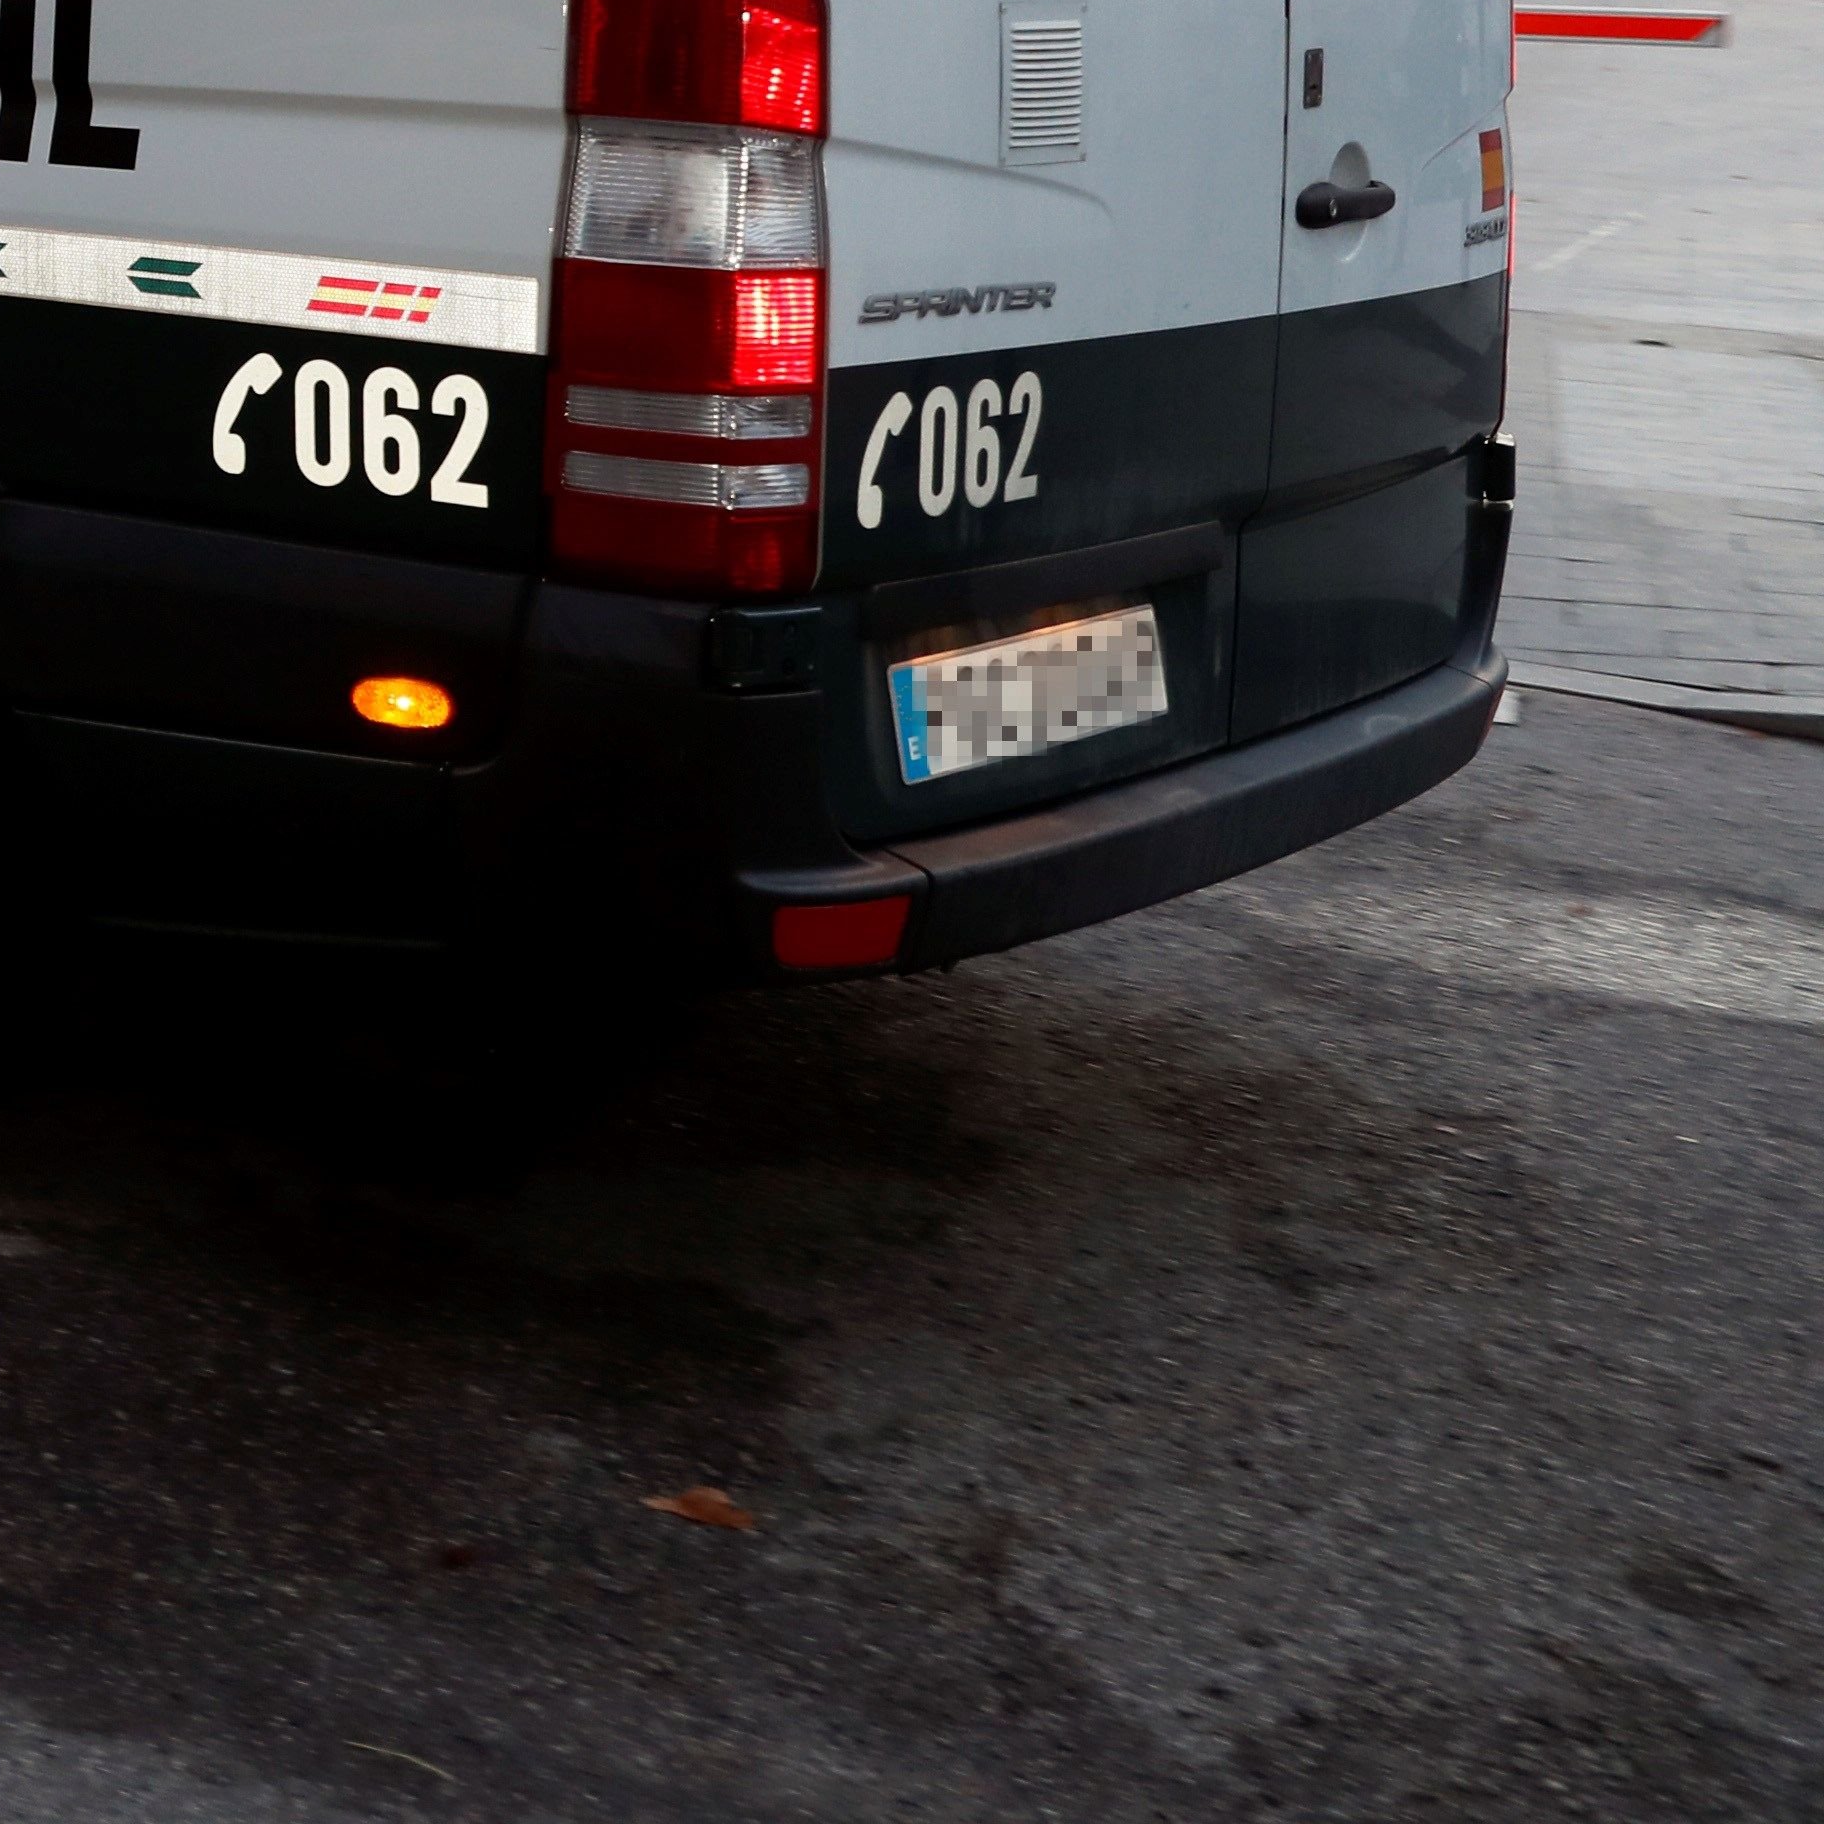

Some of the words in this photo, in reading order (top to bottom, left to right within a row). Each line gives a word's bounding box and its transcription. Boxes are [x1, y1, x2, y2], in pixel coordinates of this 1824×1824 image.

[856, 280, 1057, 326] SPRINTER
[294, 358, 490, 509] 062
[917, 370, 1045, 518] 062
